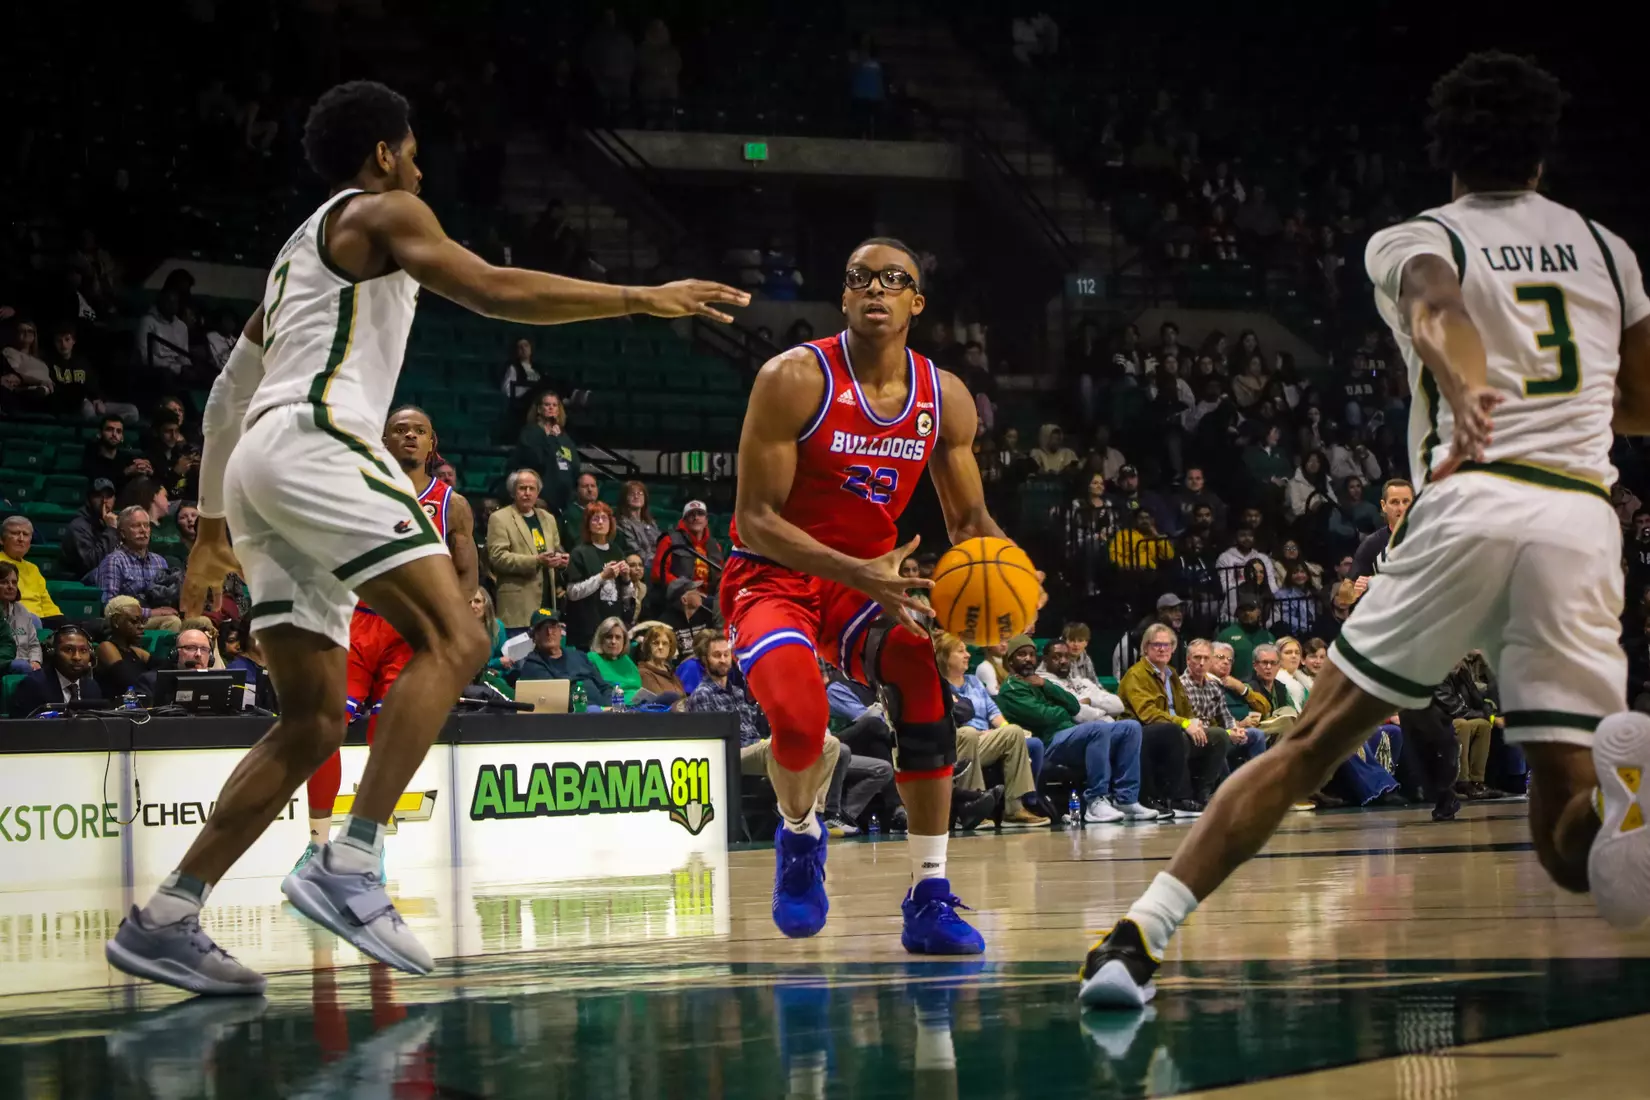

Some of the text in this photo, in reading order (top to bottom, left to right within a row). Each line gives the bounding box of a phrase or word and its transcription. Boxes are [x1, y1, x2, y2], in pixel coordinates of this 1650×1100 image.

[1482, 244, 1579, 271] LOVAN
[1076, 278, 1096, 295] 112
[1513, 282, 1583, 399] 3
[830, 430, 927, 462] BULLDOGS
[840, 464, 899, 505] 22
[470, 757, 710, 820] ALABAMA 811
